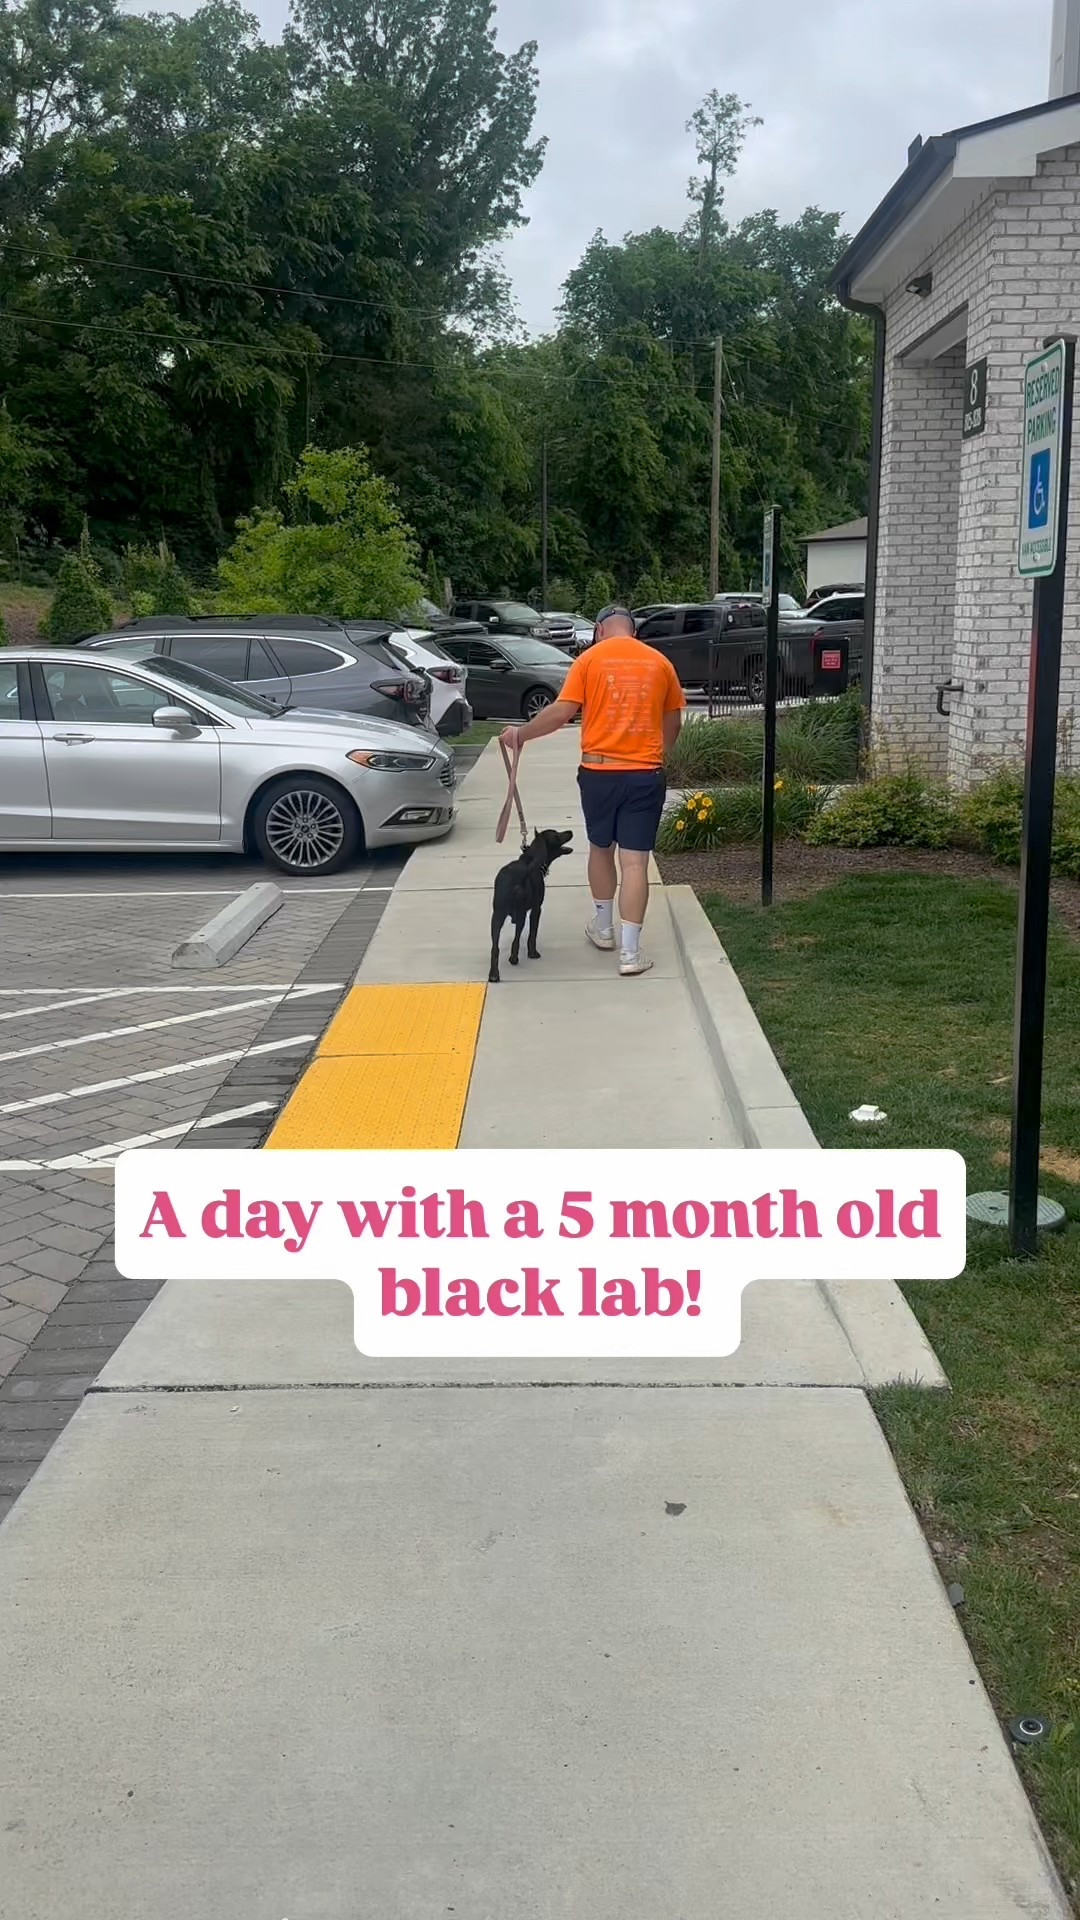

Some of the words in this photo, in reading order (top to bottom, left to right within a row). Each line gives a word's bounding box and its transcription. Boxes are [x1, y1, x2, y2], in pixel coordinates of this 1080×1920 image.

[969, 368, 978, 405] 8
[1026, 366, 1059, 408] RESERVED
[1027, 406, 1056, 445] PARKING
